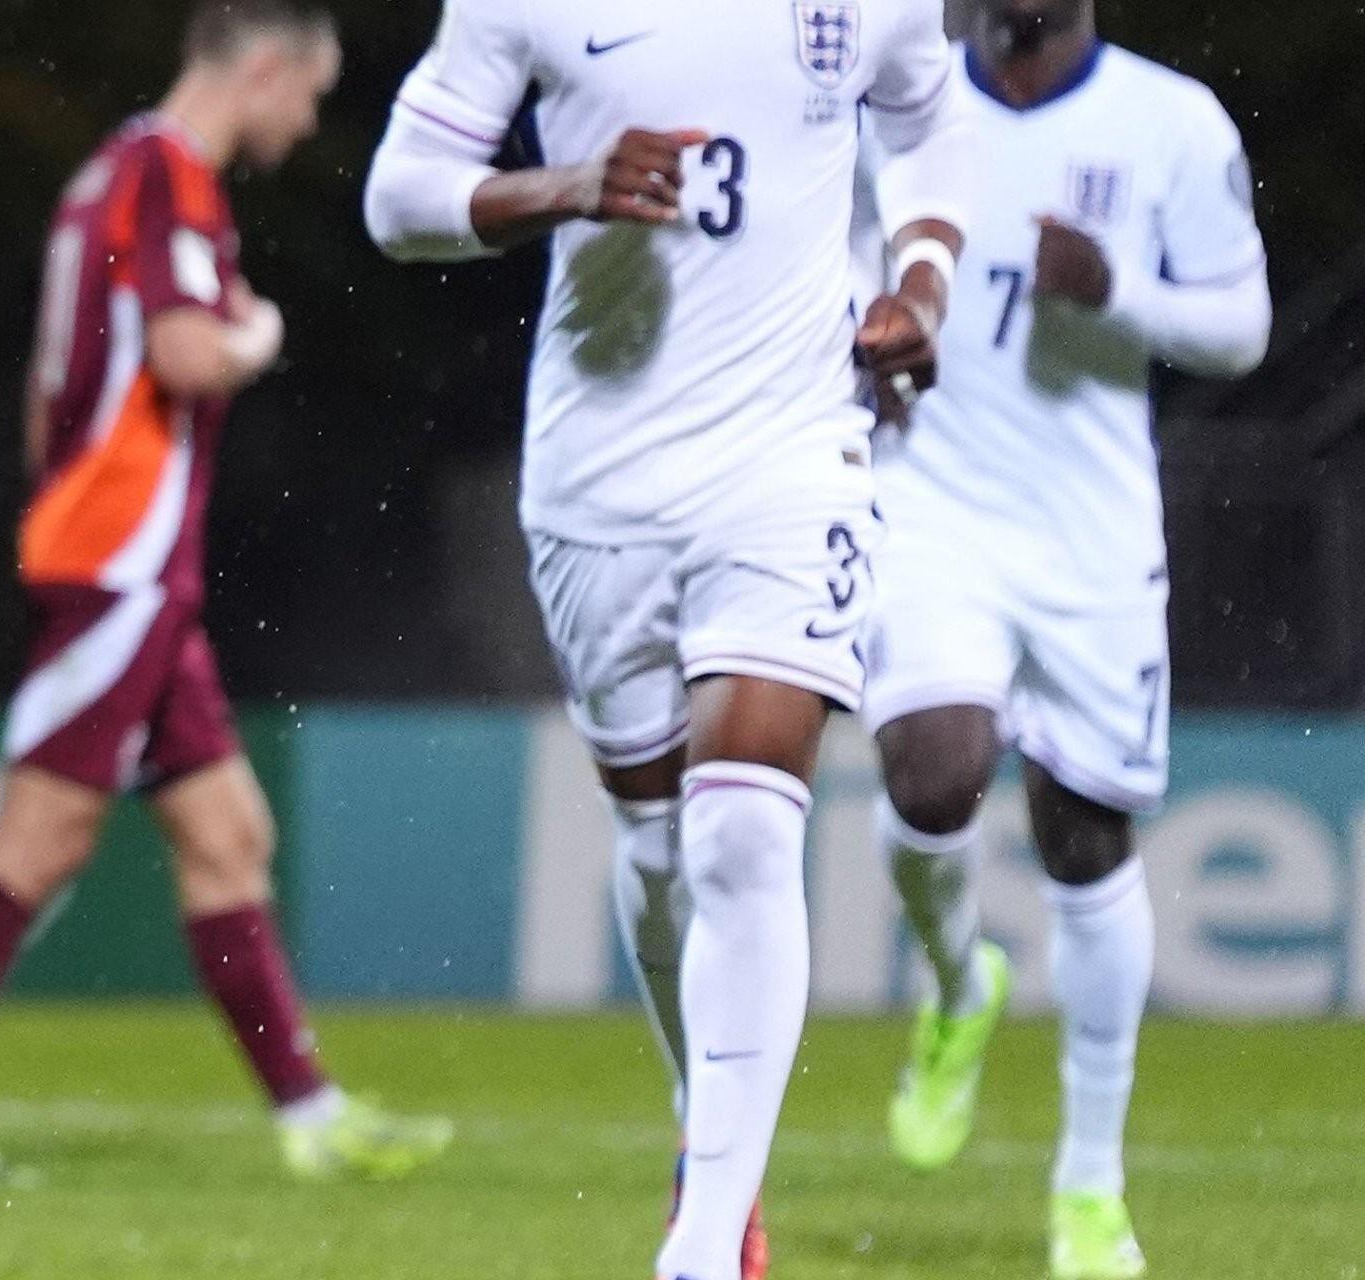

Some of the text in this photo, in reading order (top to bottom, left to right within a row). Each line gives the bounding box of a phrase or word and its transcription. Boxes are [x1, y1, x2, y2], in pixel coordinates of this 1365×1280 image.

[698, 137, 747, 239] 3
[989, 266, 1021, 347] 7
[827, 525, 860, 609] 3
